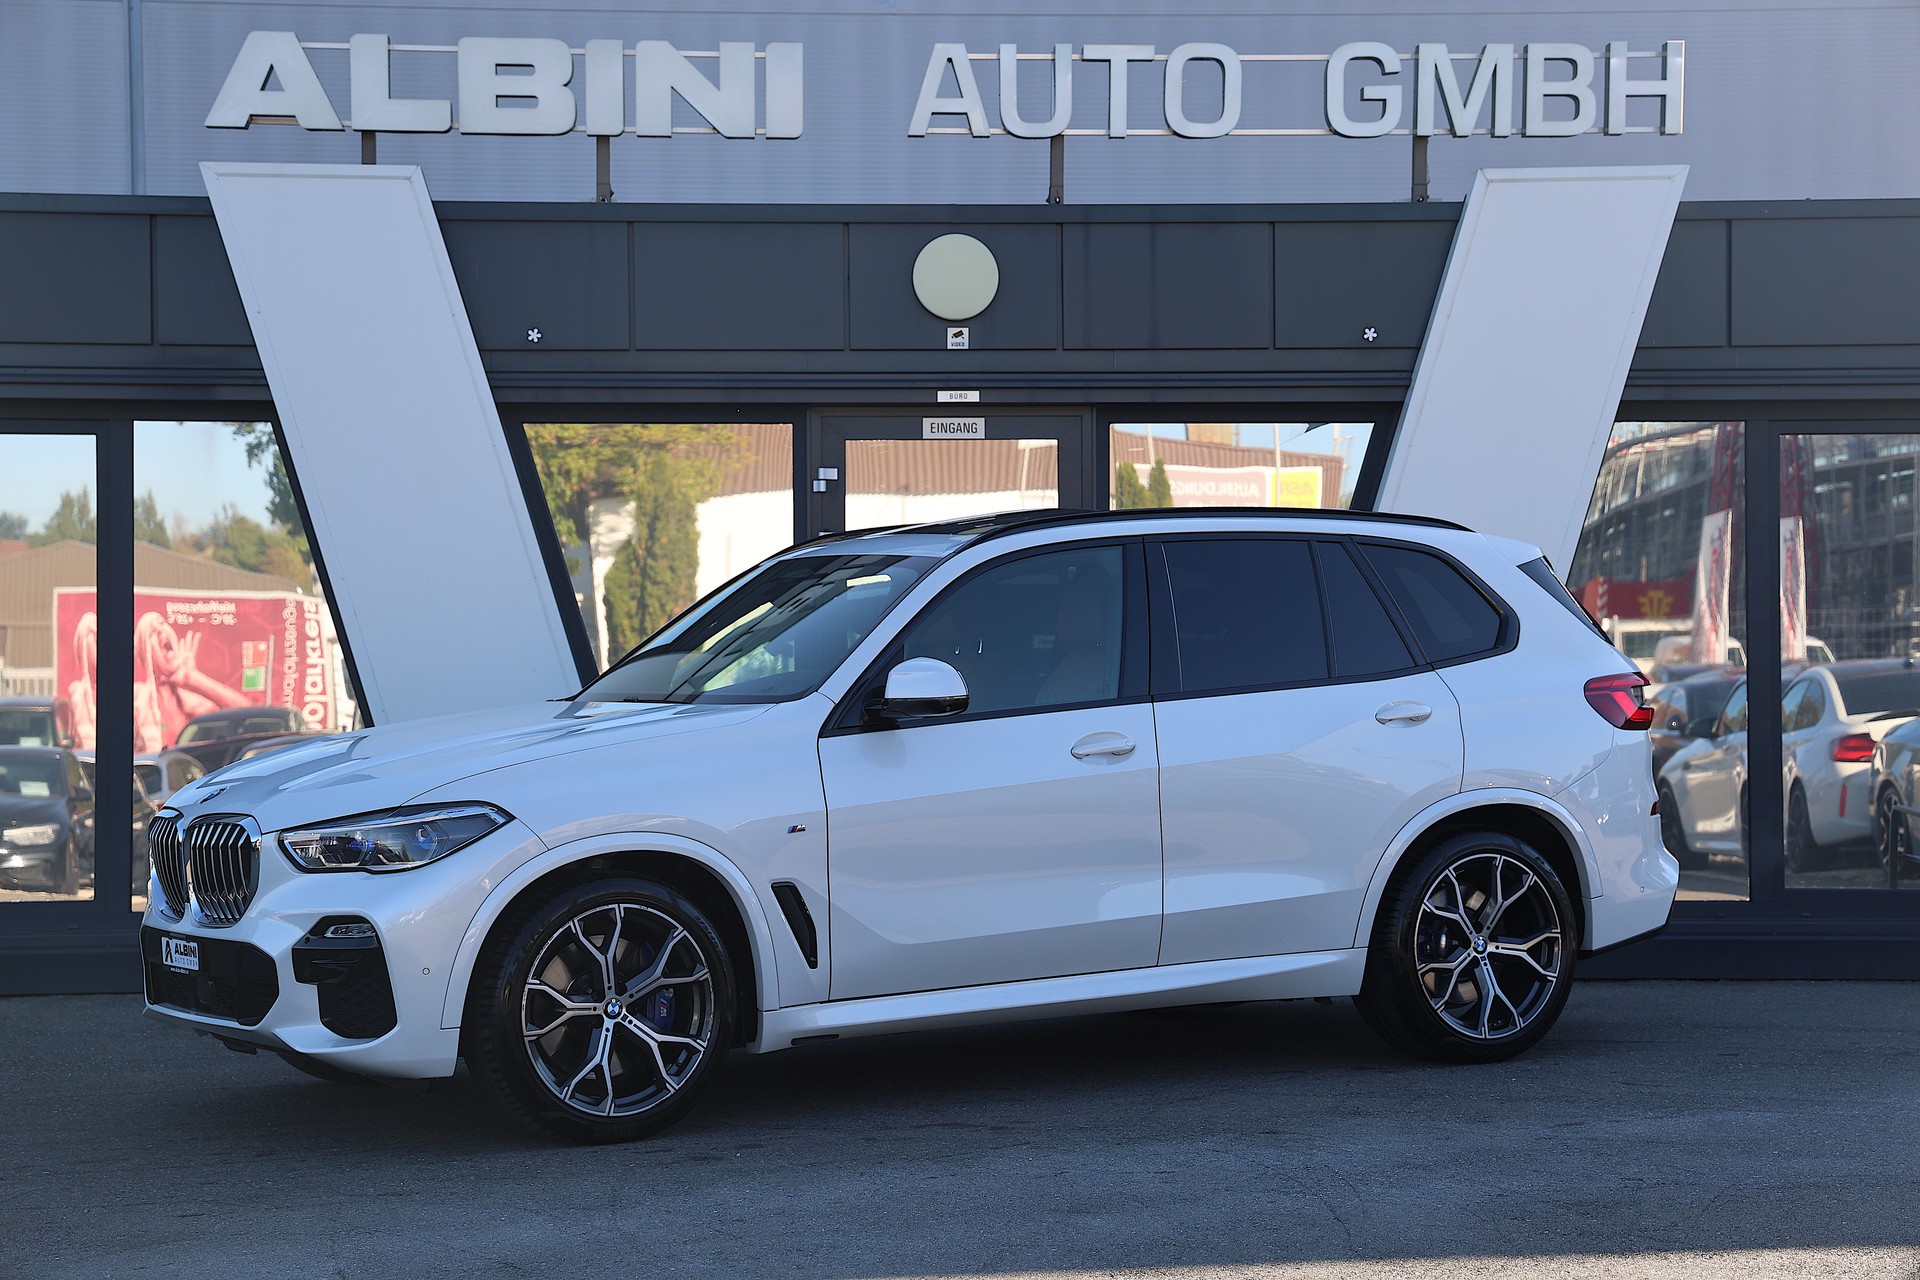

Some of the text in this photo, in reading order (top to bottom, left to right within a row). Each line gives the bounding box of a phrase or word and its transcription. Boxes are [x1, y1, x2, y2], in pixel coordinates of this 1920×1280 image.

[204, 31, 1686, 140] ALBINI AUTO GMBH
[930, 422, 978, 434] EINGANG
[174, 942, 197, 958] ALBINI
